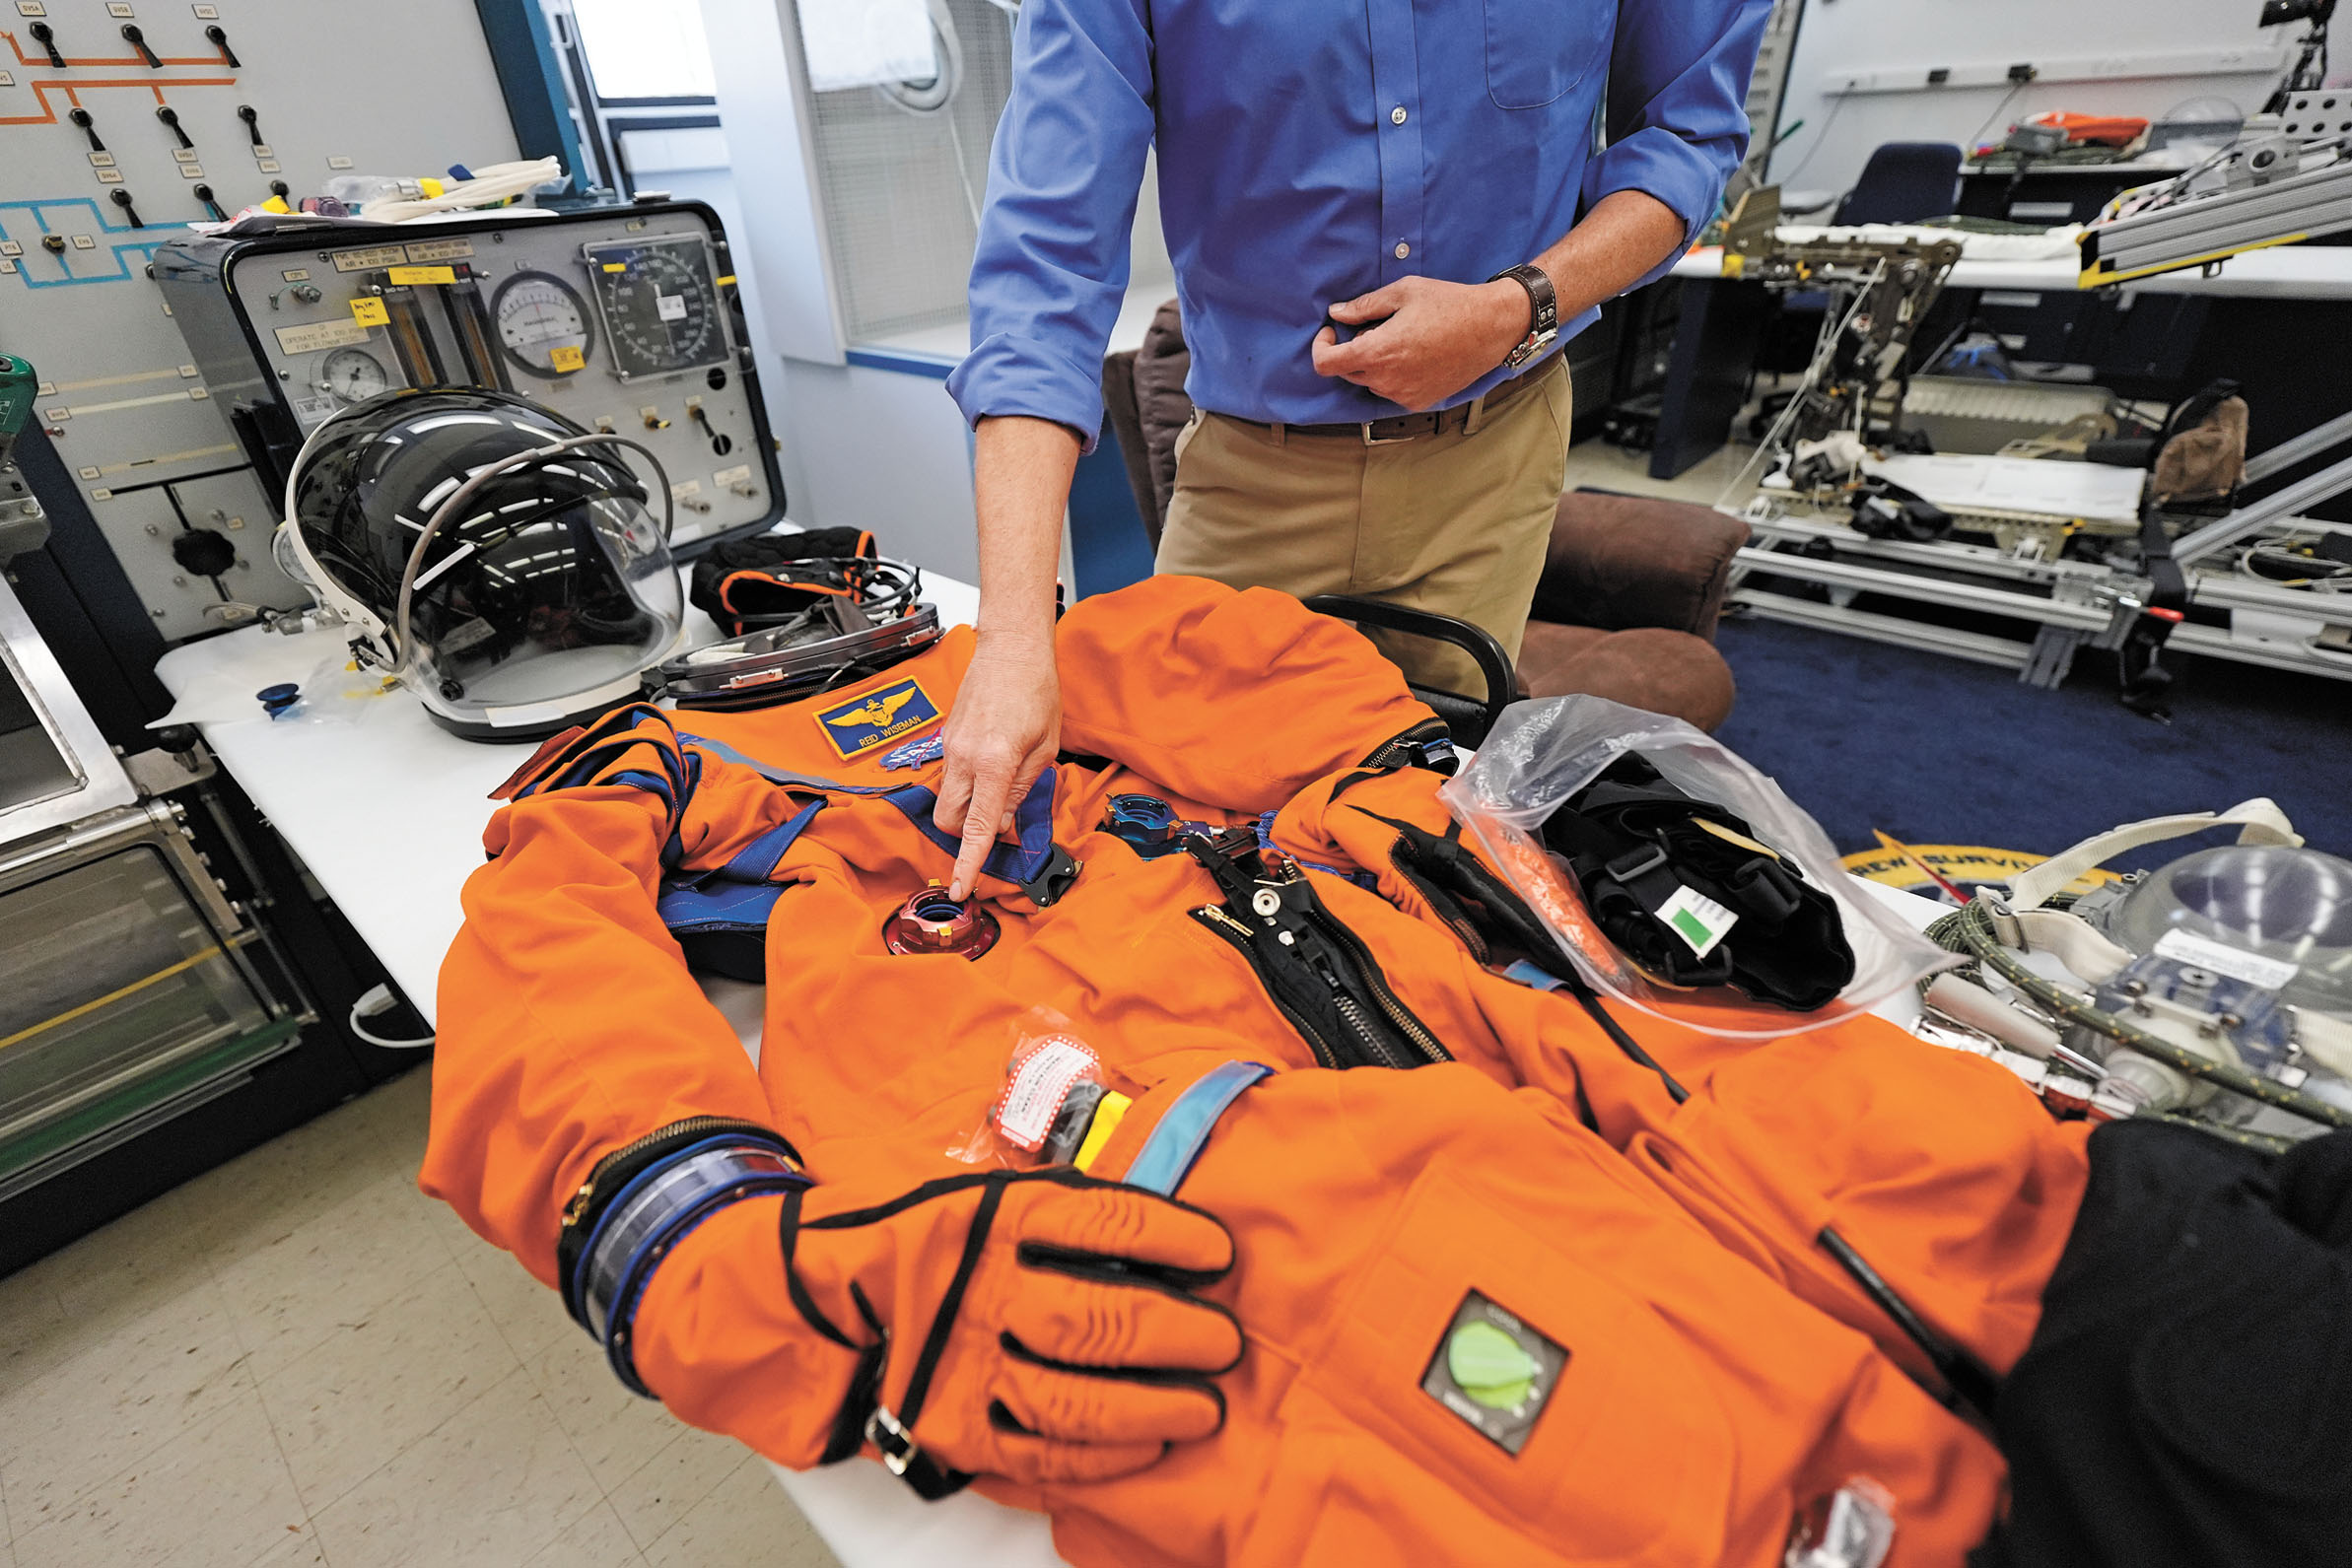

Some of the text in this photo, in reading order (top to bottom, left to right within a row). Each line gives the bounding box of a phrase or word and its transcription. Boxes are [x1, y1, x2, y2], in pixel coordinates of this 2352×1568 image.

[859, 716, 923, 748] REID WISEMAN
[1850, 856, 1909, 878] REW
